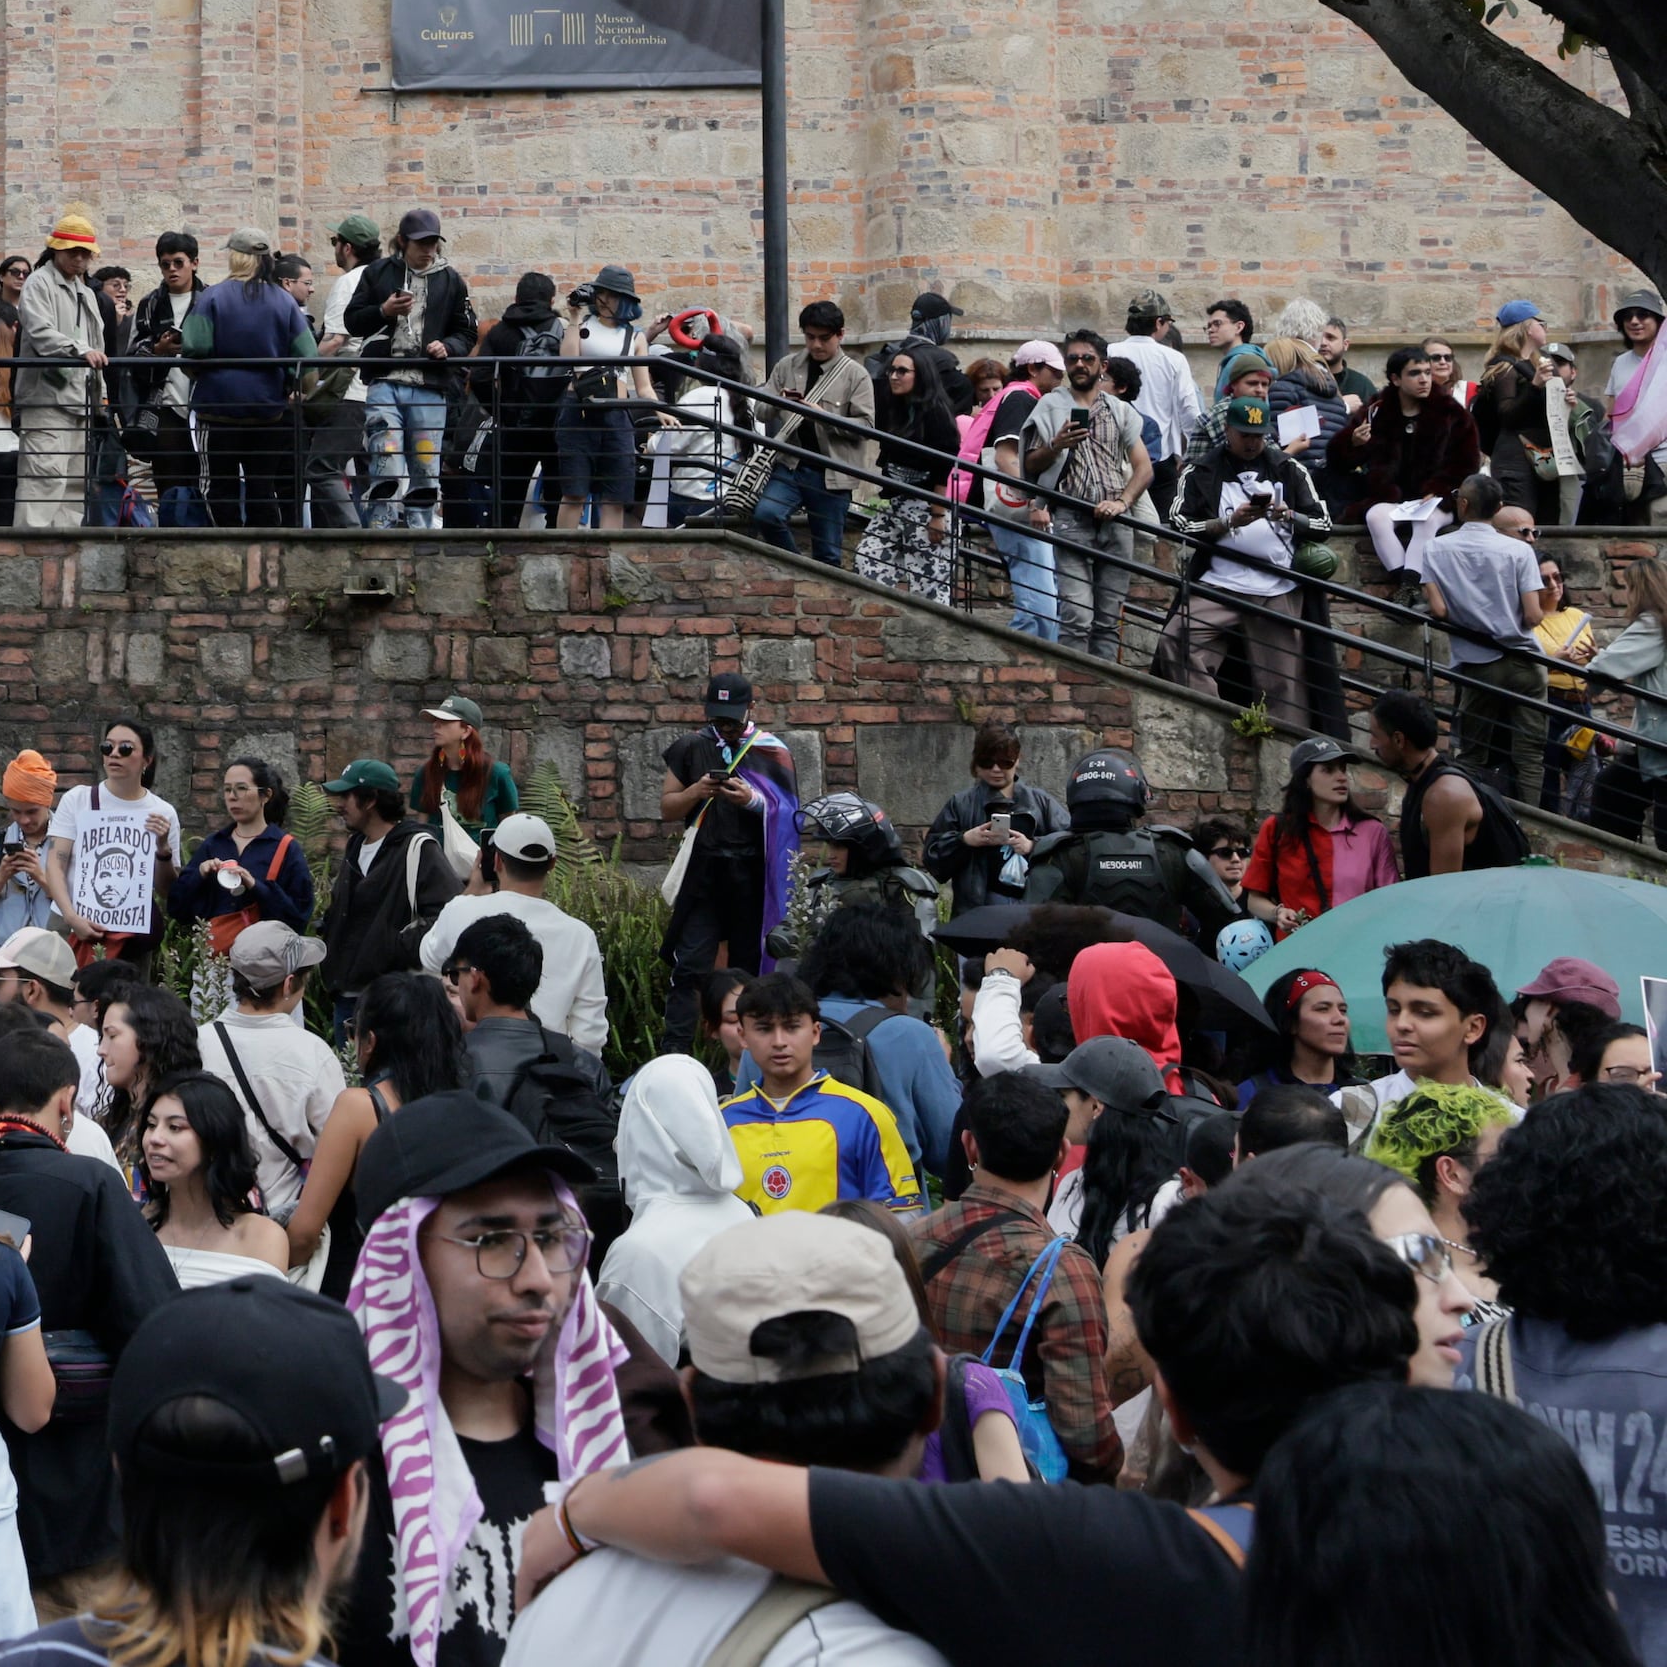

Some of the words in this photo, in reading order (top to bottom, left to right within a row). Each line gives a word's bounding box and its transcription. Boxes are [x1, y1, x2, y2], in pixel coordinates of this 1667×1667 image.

[595, 14, 634, 23] Museo
[420, 29, 474, 41] Culturas
[595, 24, 645, 34] Nacional
[595, 35, 609, 45] de
[612, 35, 667, 45] Colombia
[81, 826, 151, 858] ABELARDO
[99, 855, 129, 871] FASCISTA
[139, 862, 147, 876] ES
[79, 862, 89, 898] USTED
[139, 884, 145, 899] EL
[76, 901, 145, 927] TERRORISTA
